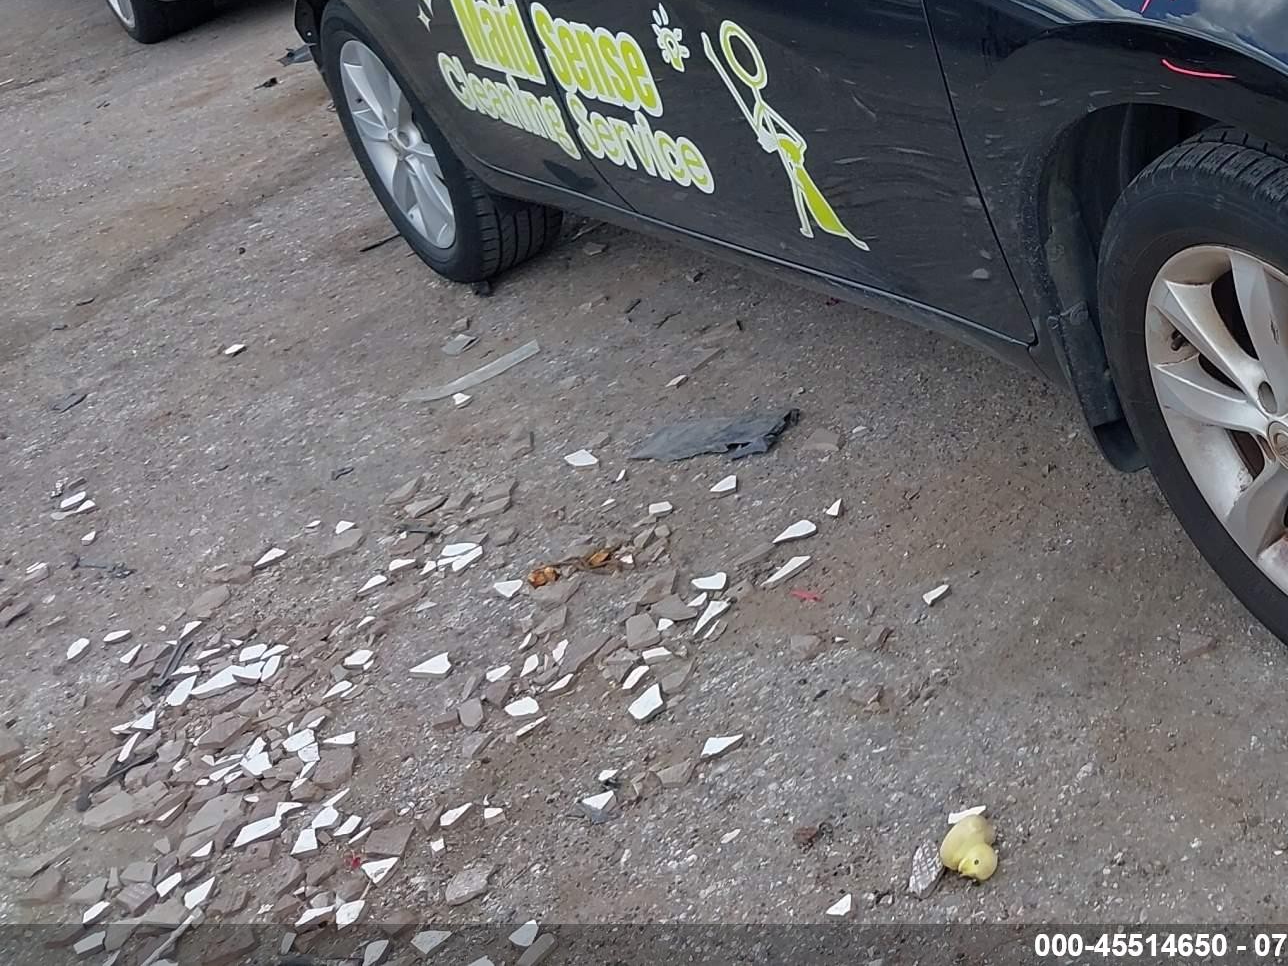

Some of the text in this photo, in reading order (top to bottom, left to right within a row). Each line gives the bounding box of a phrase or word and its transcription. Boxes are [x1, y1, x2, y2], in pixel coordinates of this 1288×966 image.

[437, 51, 715, 194] Cleaning Service
[530, 2, 664, 118] Sense
